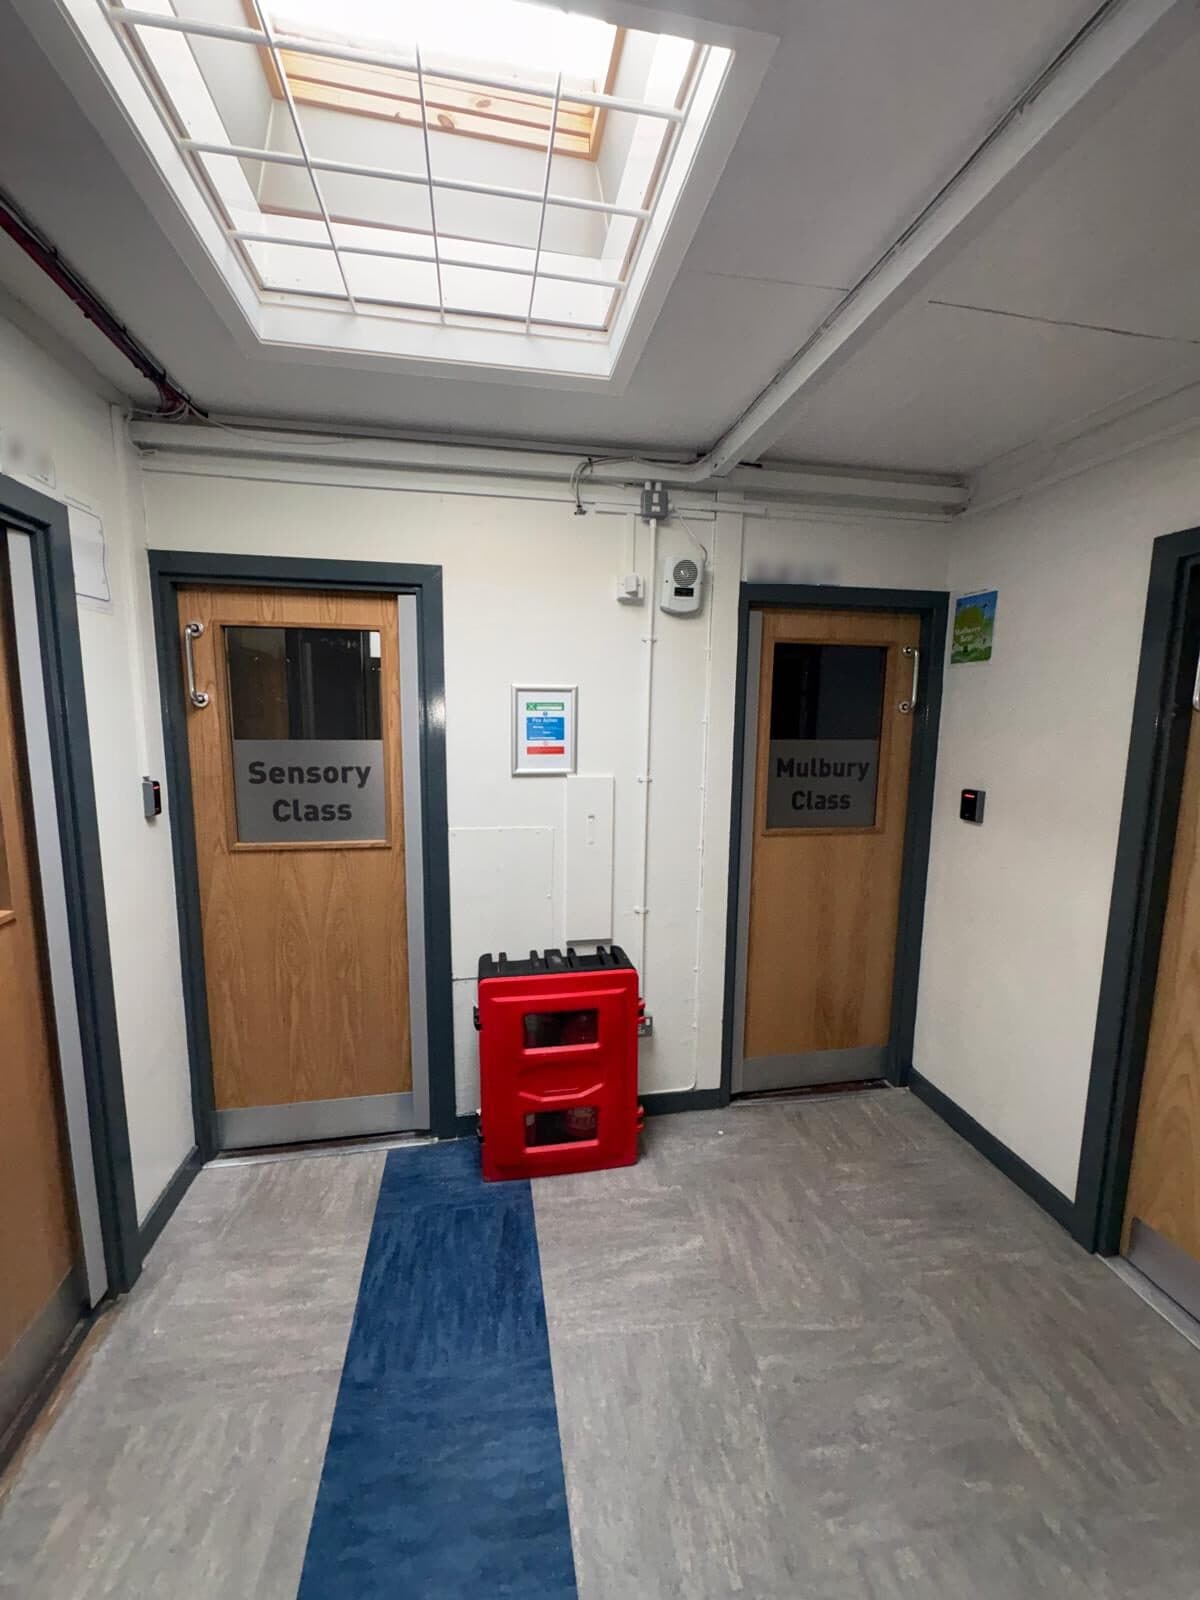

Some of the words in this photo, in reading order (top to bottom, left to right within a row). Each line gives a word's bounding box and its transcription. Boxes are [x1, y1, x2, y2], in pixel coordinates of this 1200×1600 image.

[248, 761, 372, 789] Sensory
[776, 757, 870, 782] Mulbury
[272, 799, 353, 822] Class
[791, 790, 852, 811] Class
